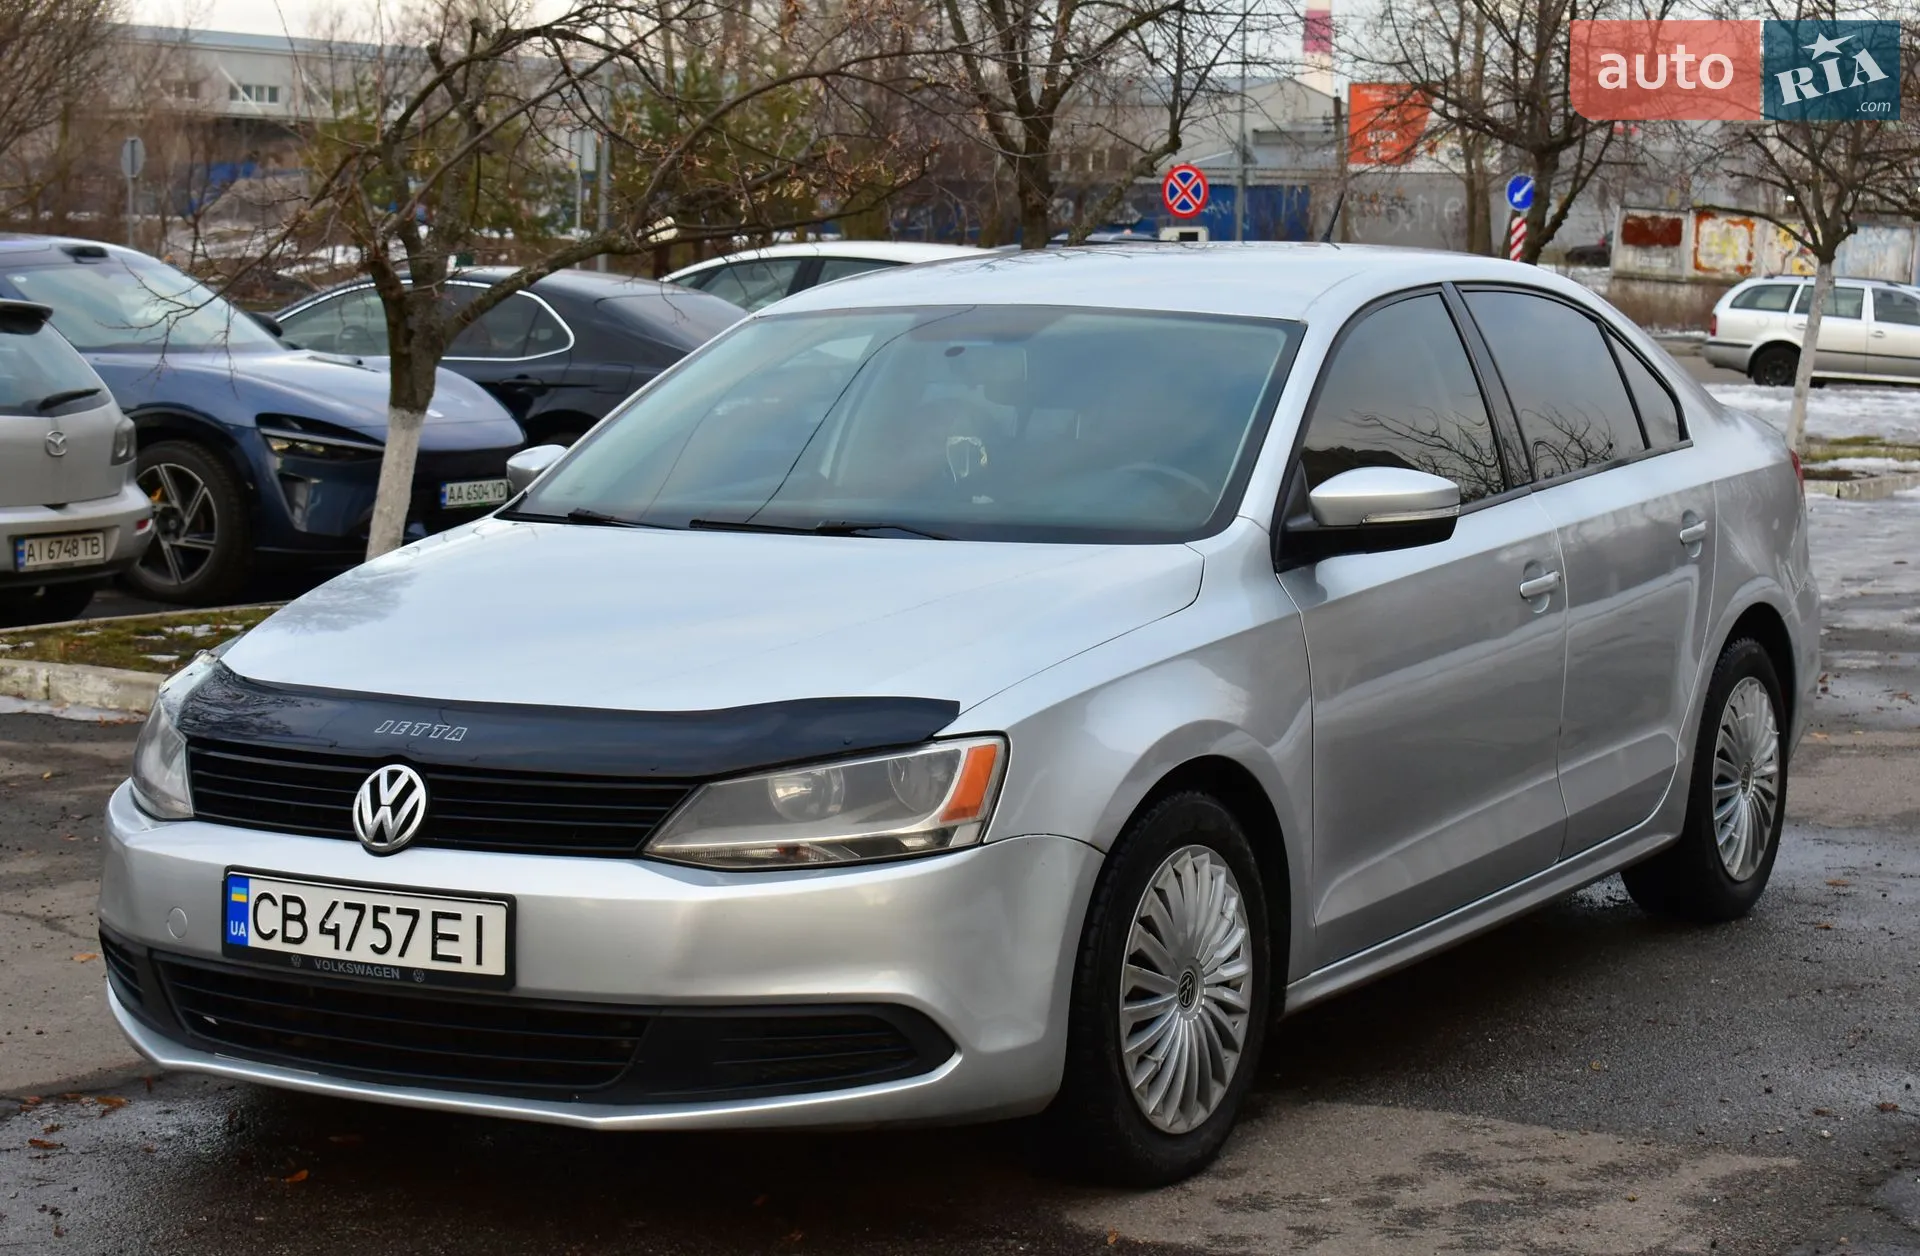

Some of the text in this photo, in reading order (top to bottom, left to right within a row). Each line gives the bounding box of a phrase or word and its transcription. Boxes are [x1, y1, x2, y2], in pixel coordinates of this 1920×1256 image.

[448, 482, 506, 503] AA 6504 YD
[27, 536, 101, 562] AI 6748 TB
[374, 719, 468, 741] JETTA
[229, 891, 484, 966] UA CB 4757 EI
[314, 957, 401, 980] VOLKSWAGEN
